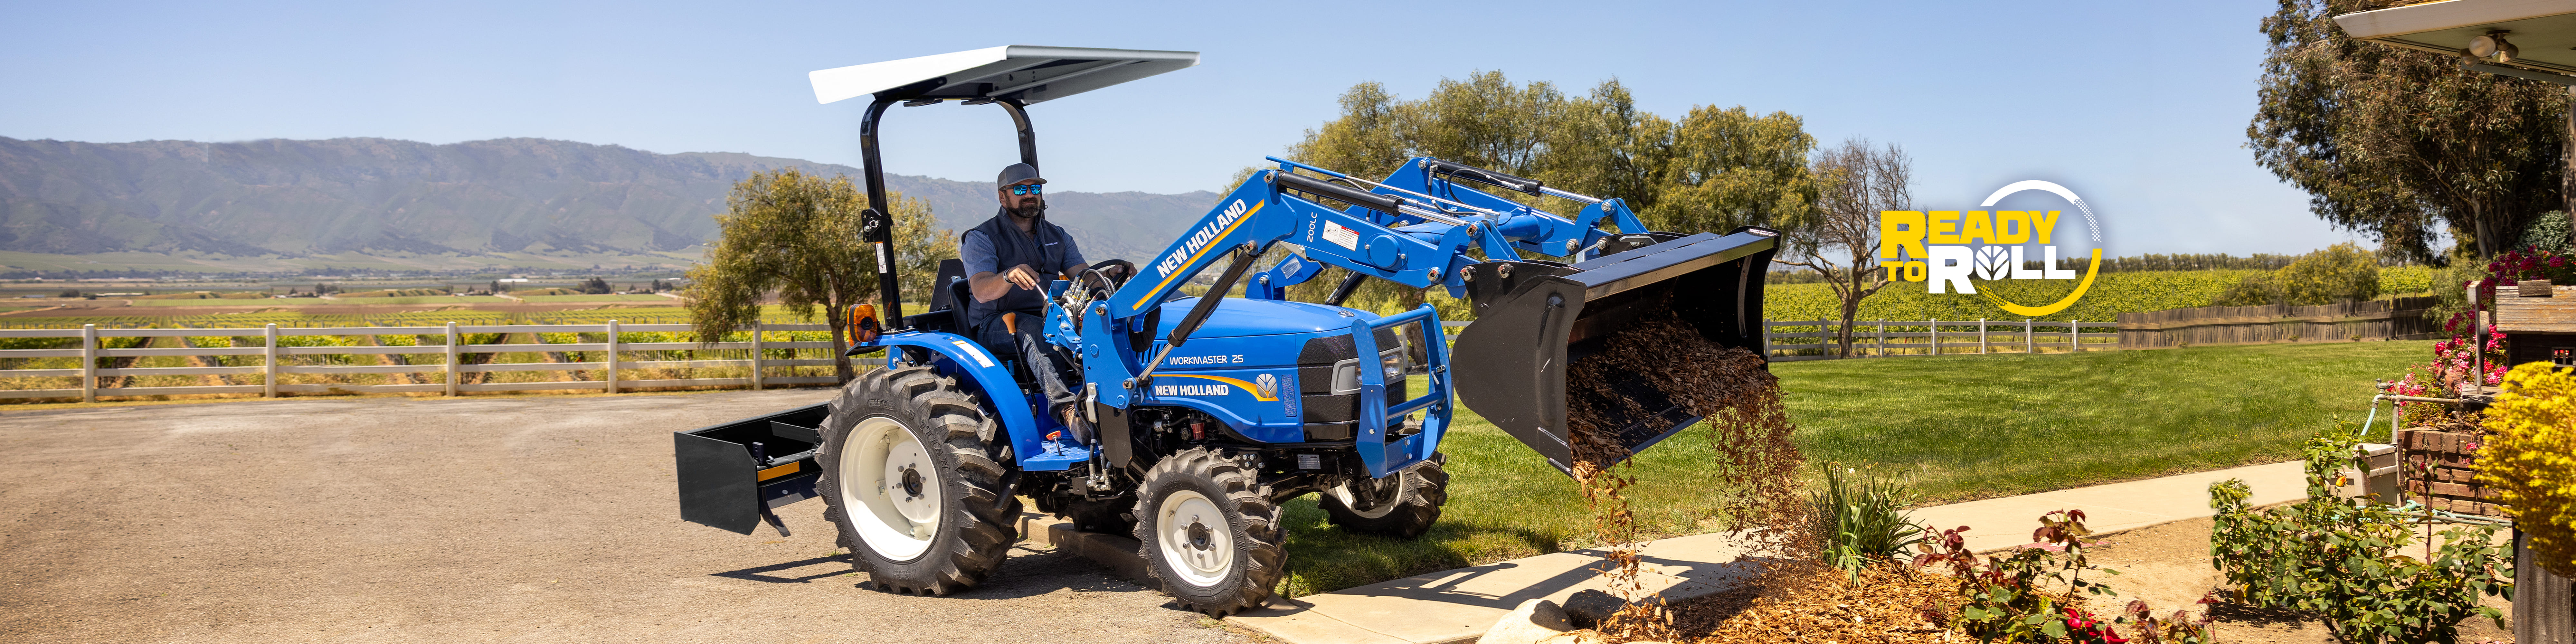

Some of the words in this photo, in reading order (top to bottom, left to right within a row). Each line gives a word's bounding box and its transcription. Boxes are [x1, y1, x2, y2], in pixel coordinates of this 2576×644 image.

[1156, 245, 1188, 279] NEW
[1186, 199, 1246, 255] HOLLAND
[1307, 212, 1317, 242] 200LC
[1170, 355, 1228, 365] WORKMASTER
[1232, 355, 1244, 363] 25
[1155, 385, 1178, 396] NEW
[1180, 384, 1229, 396] HOLLAND
[919, 419, 949, 468] TITAN
[1225, 505, 1246, 550] TITAN
[1143, 534, 1169, 584] HI-TRACTION
